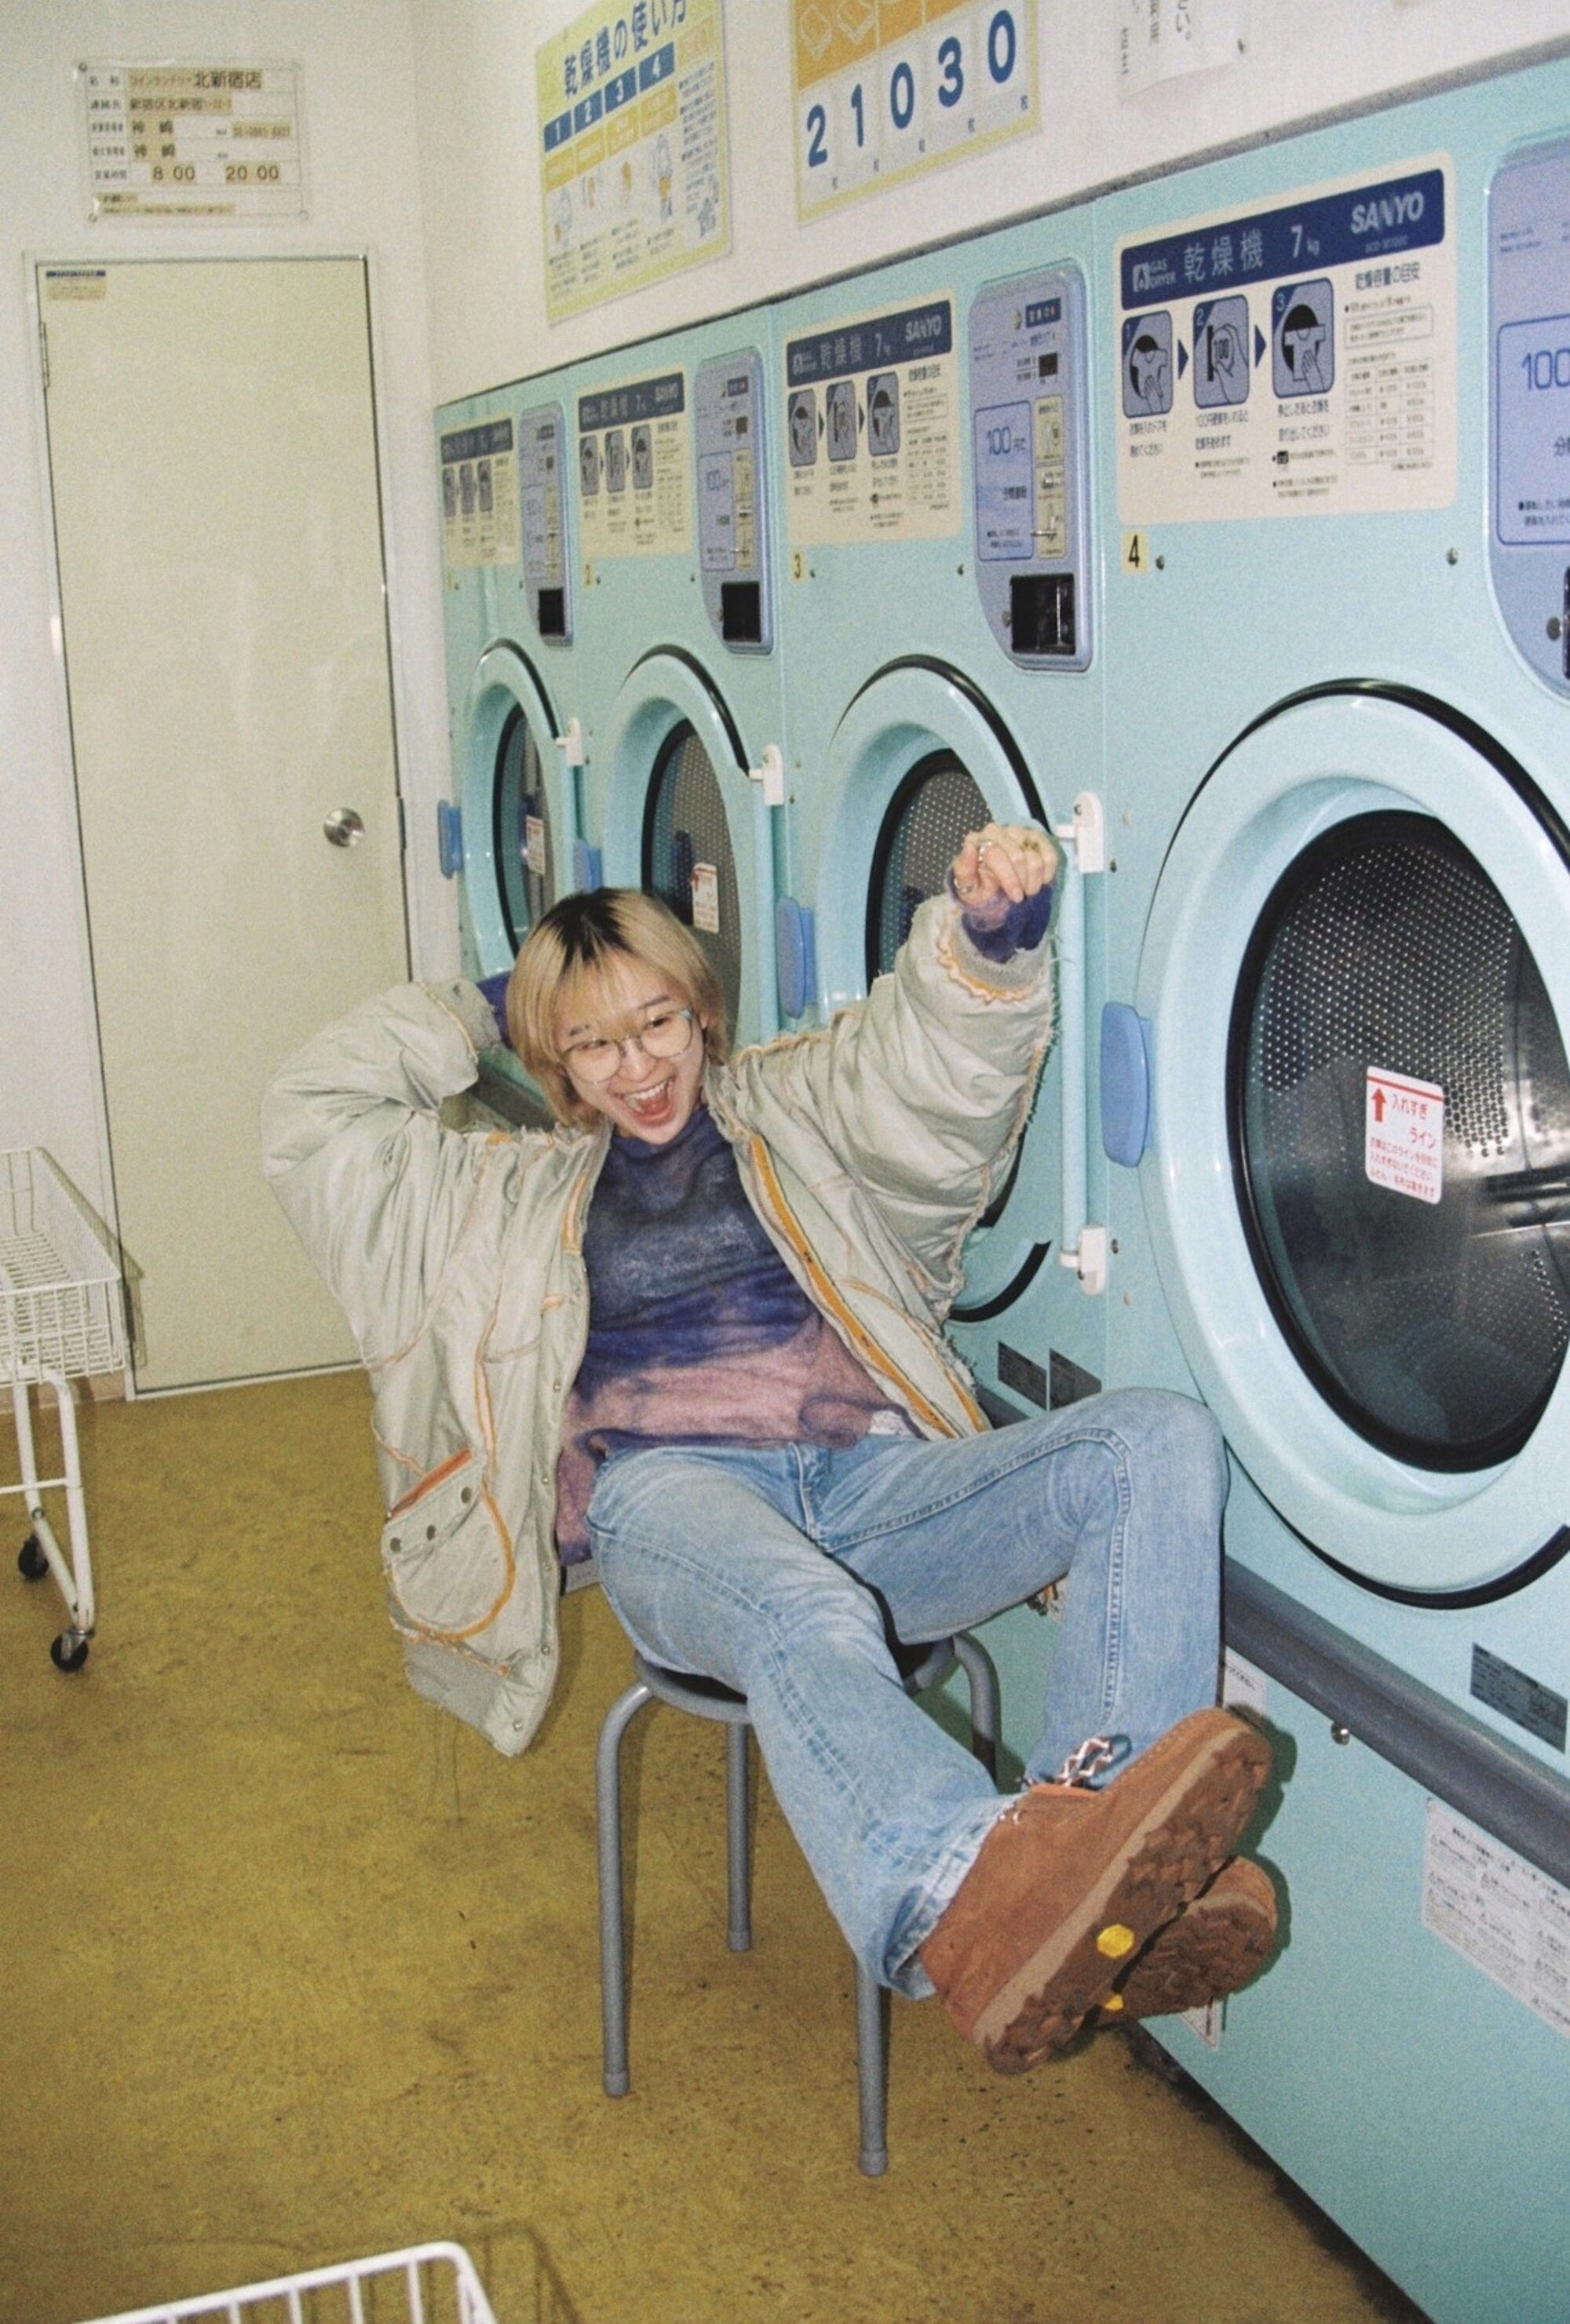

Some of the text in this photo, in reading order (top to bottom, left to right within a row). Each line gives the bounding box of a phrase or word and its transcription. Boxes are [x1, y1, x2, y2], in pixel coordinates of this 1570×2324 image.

[652, 54, 662, 79] 4
[153, 166, 163, 181] 8
[1351, 192, 1423, 234] SANYO
[905, 315, 942, 343] SANYO
[1129, 534, 1140, 568] 4
[794, 553, 801, 579] 3
